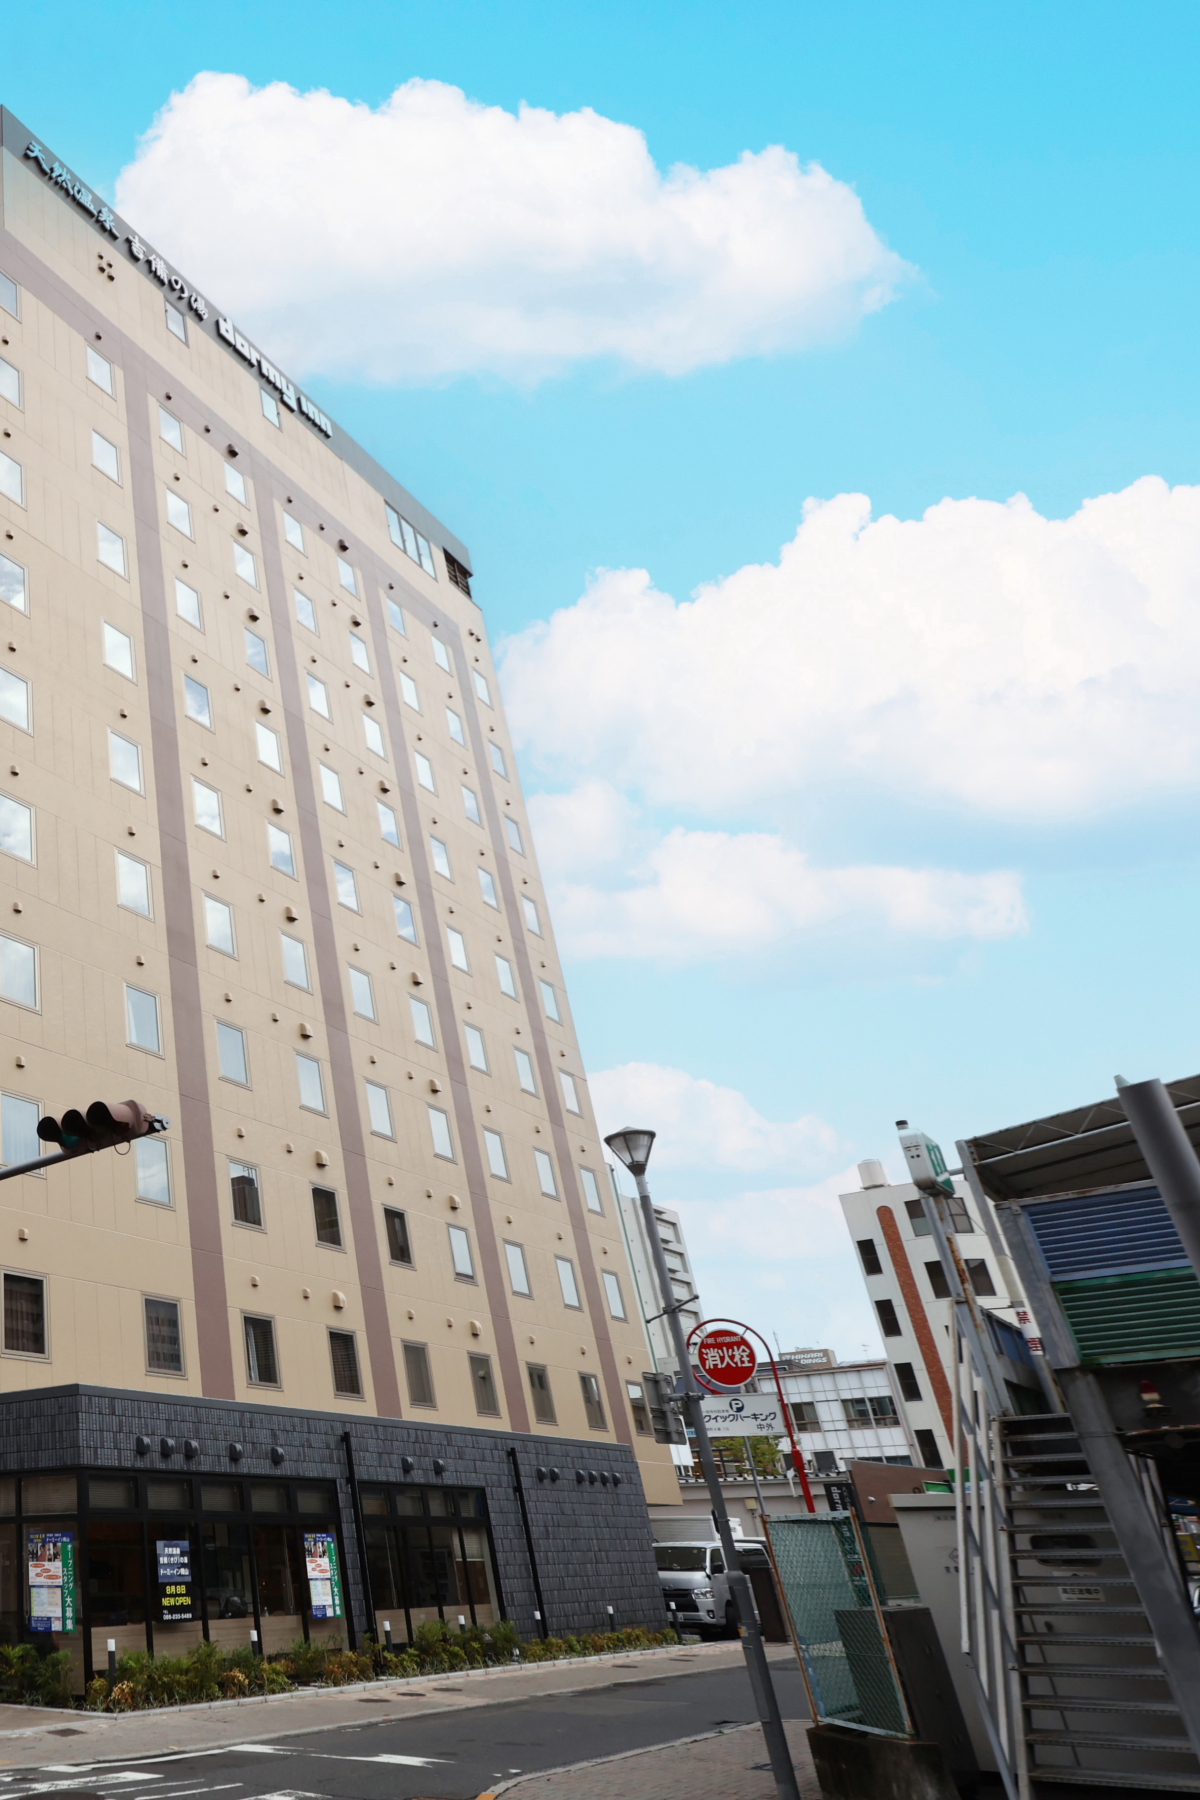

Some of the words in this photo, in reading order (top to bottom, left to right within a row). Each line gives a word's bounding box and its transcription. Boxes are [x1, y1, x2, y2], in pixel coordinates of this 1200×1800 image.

[24, 140, 120, 240] 天然温泉
[125, 234, 209, 321] 吉備の湯
[216, 316, 298, 413] dormy
[299, 394, 333, 439] inn
[703, 1336, 716, 1345] FIRE
[716, 1335, 742, 1344] HYDRANT
[701, 1345, 753, 1370] 消火栓
[791, 1352, 824, 1361] HIKARI
[164, 1547, 181, 1555] 天然温泉
[66, 1543, 74, 1591] オープニング
[160, 1568, 189, 1576] ドーミーイン岡山
[162, 1597, 175, 1606] NEW
[175, 1596, 191, 1605] OPEN
[333, 1587, 341, 1615] 大募集
[66, 1596, 74, 1631] 大募集
